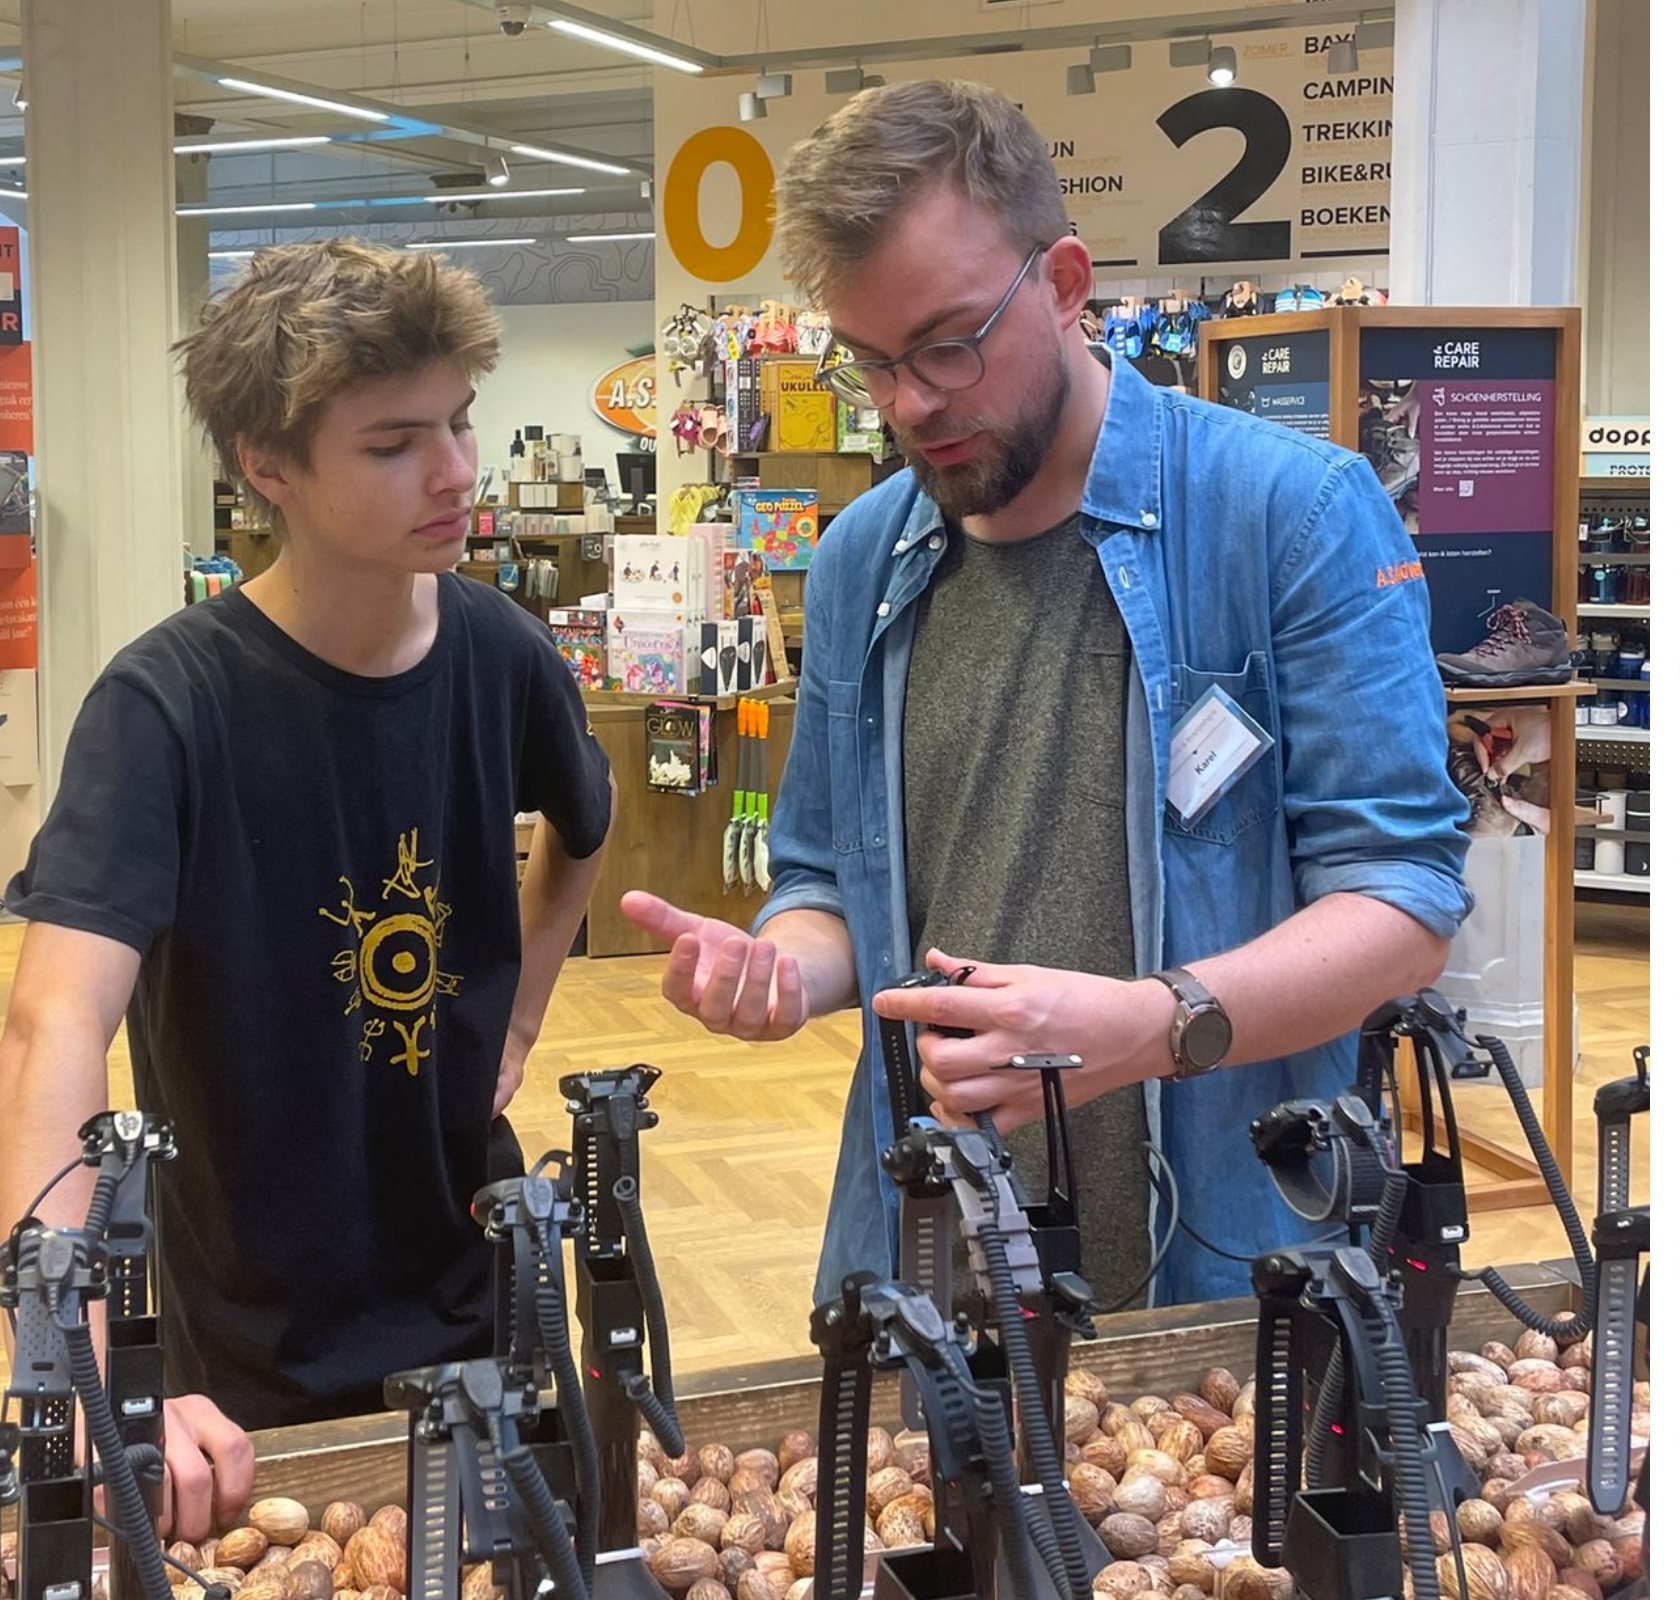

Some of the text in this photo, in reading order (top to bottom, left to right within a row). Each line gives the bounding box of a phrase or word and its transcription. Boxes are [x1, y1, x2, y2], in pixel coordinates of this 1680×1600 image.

[1304, 34, 1356, 54] BAY
[1156, 87, 1292, 265] 2
[1268, 347, 1291, 361] CARE
[1444, 341, 1480, 355] CARE
[1262, 361, 1291, 374] REPAIR
[1434, 355, 1480, 369] REPAIR
[1450, 392, 1542, 403] SCHOENHERSTELLING
[1588, 427, 1650, 446] dopp
[646, 716, 695, 739] GLOW
[1193, 749, 1218, 776] Karel
